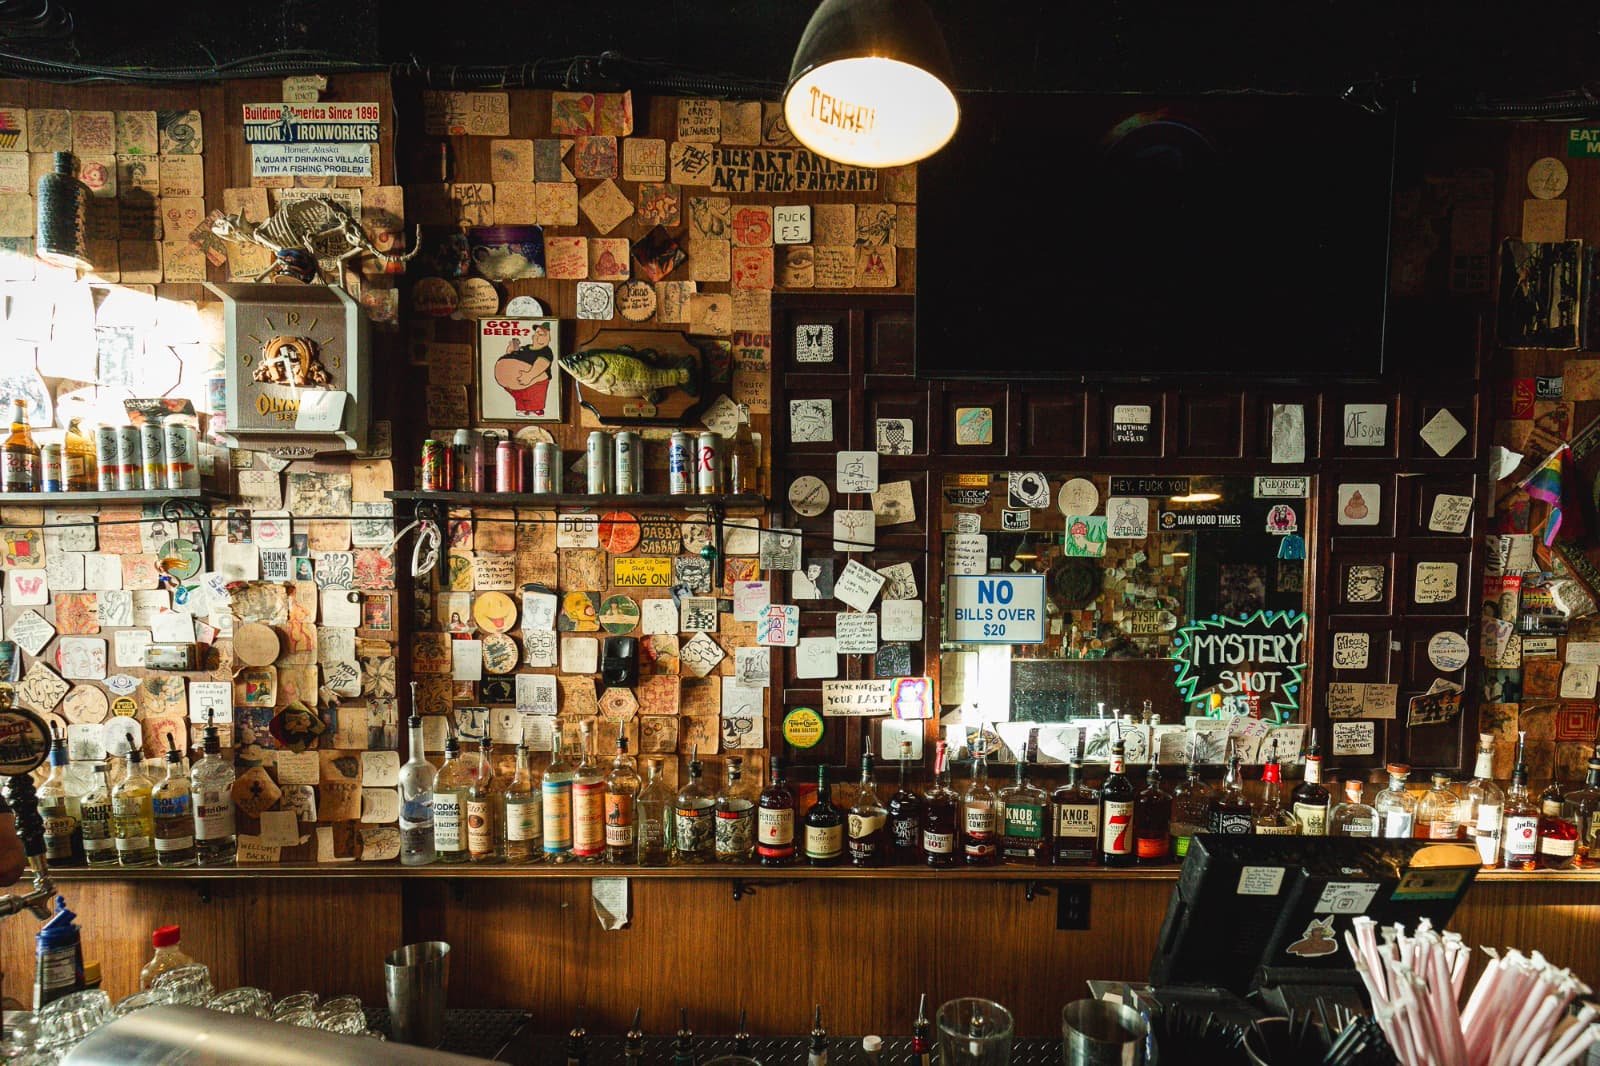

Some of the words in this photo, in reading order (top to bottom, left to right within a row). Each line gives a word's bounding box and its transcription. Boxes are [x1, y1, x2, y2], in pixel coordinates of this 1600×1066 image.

[245, 106, 281, 121] Building
[328, 107, 353, 120] Since
[356, 106, 378, 120] 1896
[245, 125, 281, 141] UNION
[297, 125, 378, 141] IRONWORKERS
[263, 156, 292, 164] QUAINT
[295, 156, 334, 164] DRINKING
[336, 156, 370, 164] VILLAGE
[713, 150, 750, 167] FUCK
[753, 151, 793, 173] ART
[325, 166, 365, 174] PROBLEM
[712, 167, 750, 192] ART
[754, 173, 794, 192] FUCK
[777, 212, 806, 223] FUCK
[487, 321, 520, 329] GOT
[483, 329, 531, 337] BEER?
[331, 355, 341, 373] 3
[255, 393, 301, 416] OLYM
[1139, 480, 1164, 491] FUCK
[1167, 480, 1188, 491] YOU
[1265, 480, 1301, 489] GEORGE
[1177, 515, 1195, 525] DAM
[1196, 515, 1217, 525] GOOD
[1218, 514, 1241, 525] TIMES
[643, 526, 682, 539] DABBA
[641, 539, 682, 554] SABBATH
[263, 551, 287, 561] DRUNK
[263, 562, 288, 570] STONED
[616, 574, 648, 585] HANG
[978, 580, 1014, 604] NO
[955, 608, 996, 621] BILLS
[998, 608, 1036, 621] OVER
[983, 623, 1006, 637] $20
[1131, 623, 1159, 633] RIVER
[1193, 633, 1304, 667] MYSTERY
[1217, 671, 1283, 694] SHOT
[1114, 760, 1123, 773] 7
[967, 812, 996, 821] SOUTHERN
[1006, 808, 1033, 820] KNOB
[1062, 809, 1090, 820] KNOB
[1109, 815, 1132, 850] 7
